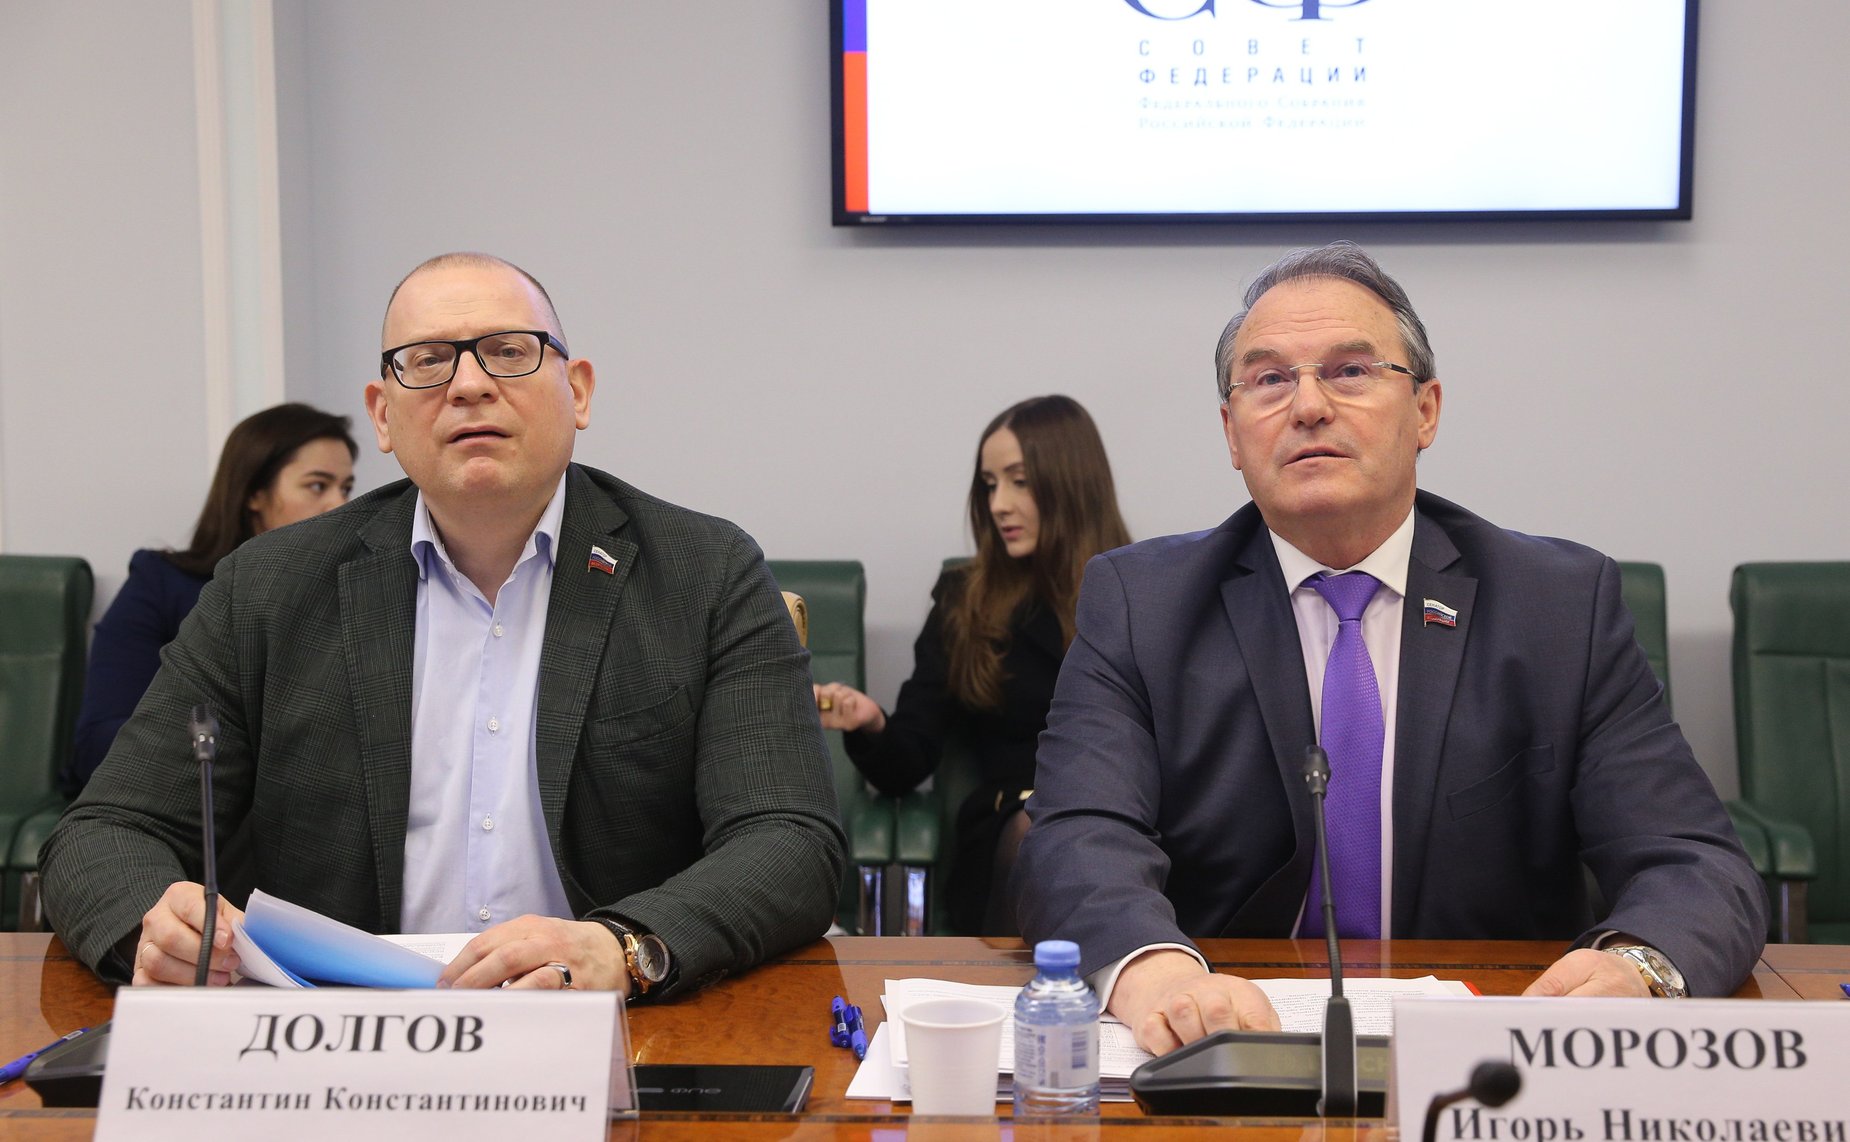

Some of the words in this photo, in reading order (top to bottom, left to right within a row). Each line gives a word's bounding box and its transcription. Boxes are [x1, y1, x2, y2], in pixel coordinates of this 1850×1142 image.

[1138, 37, 1365, 56] СОВЕТ
[1138, 66, 1367, 87] ФЕДЕРАЦИИ
[239, 1014, 484, 1060] ДОЛГОВ
[1506, 1027, 1808, 1070] МОРОЗОВ
[125, 1087, 311, 1111] Константин
[324, 1087, 587, 1112] Константинович
[1450, 1107, 1585, 1142] Игорь
